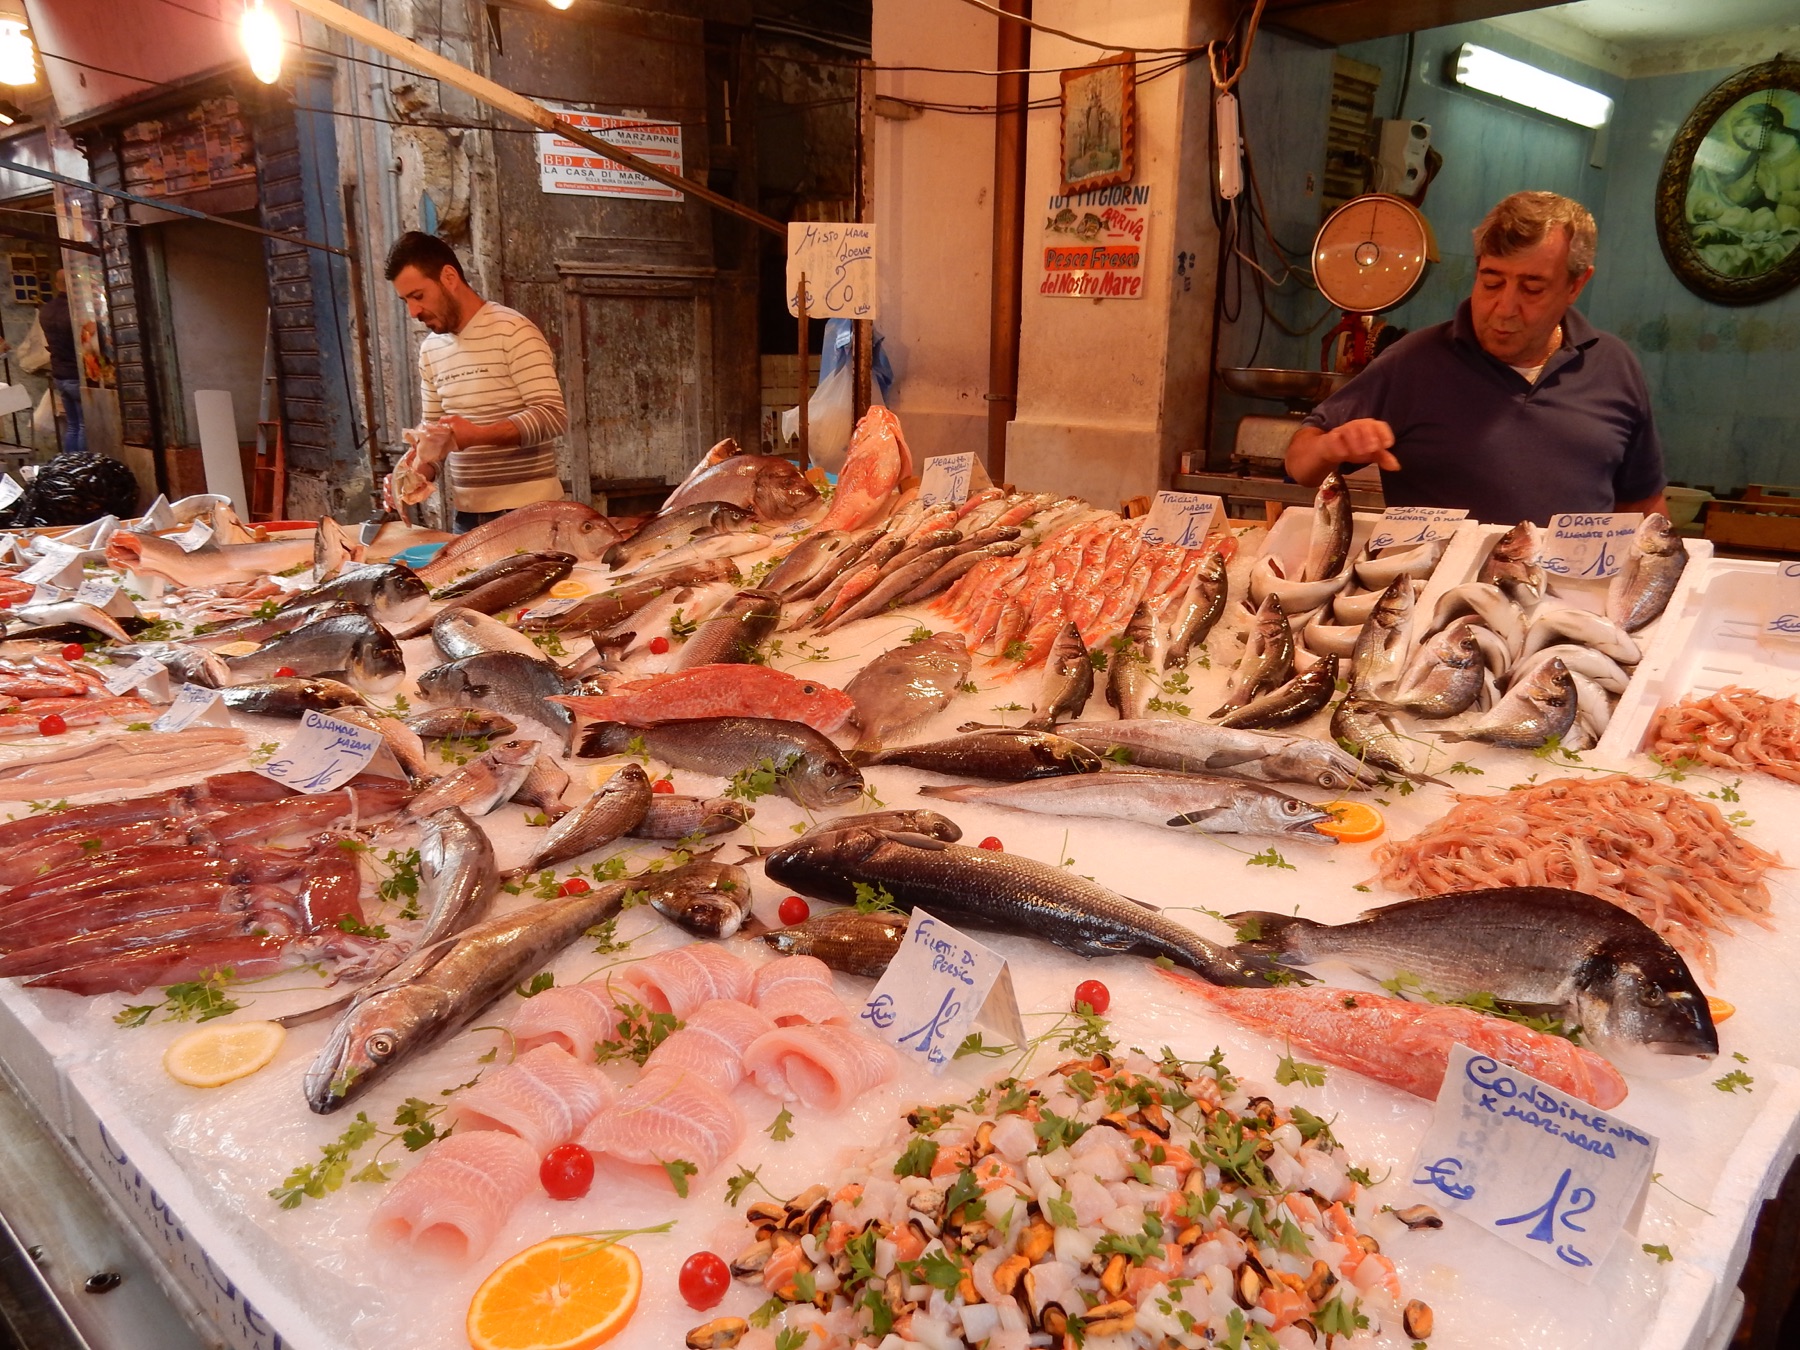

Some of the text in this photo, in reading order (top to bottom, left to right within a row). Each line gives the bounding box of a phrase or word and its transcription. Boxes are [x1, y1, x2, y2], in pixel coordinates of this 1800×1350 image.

[581, 116, 591, 126] &
[617, 132, 679, 145] MARZAPANE
[545, 155, 573, 167] BED
[582, 157, 593, 168] &
[544, 167, 558, 175] LA
[566, 168, 595, 177] CASA
[601, 170, 612, 178] DI
[1101, 207, 1144, 242] ARRIVA
[1045, 246, 1140, 269] Pesce Fresco
[1040, 271, 1141, 297] del Nostro Mare
[1557, 514, 1613, 528] ORATE
[1495, 1168, 1597, 1245] 12
